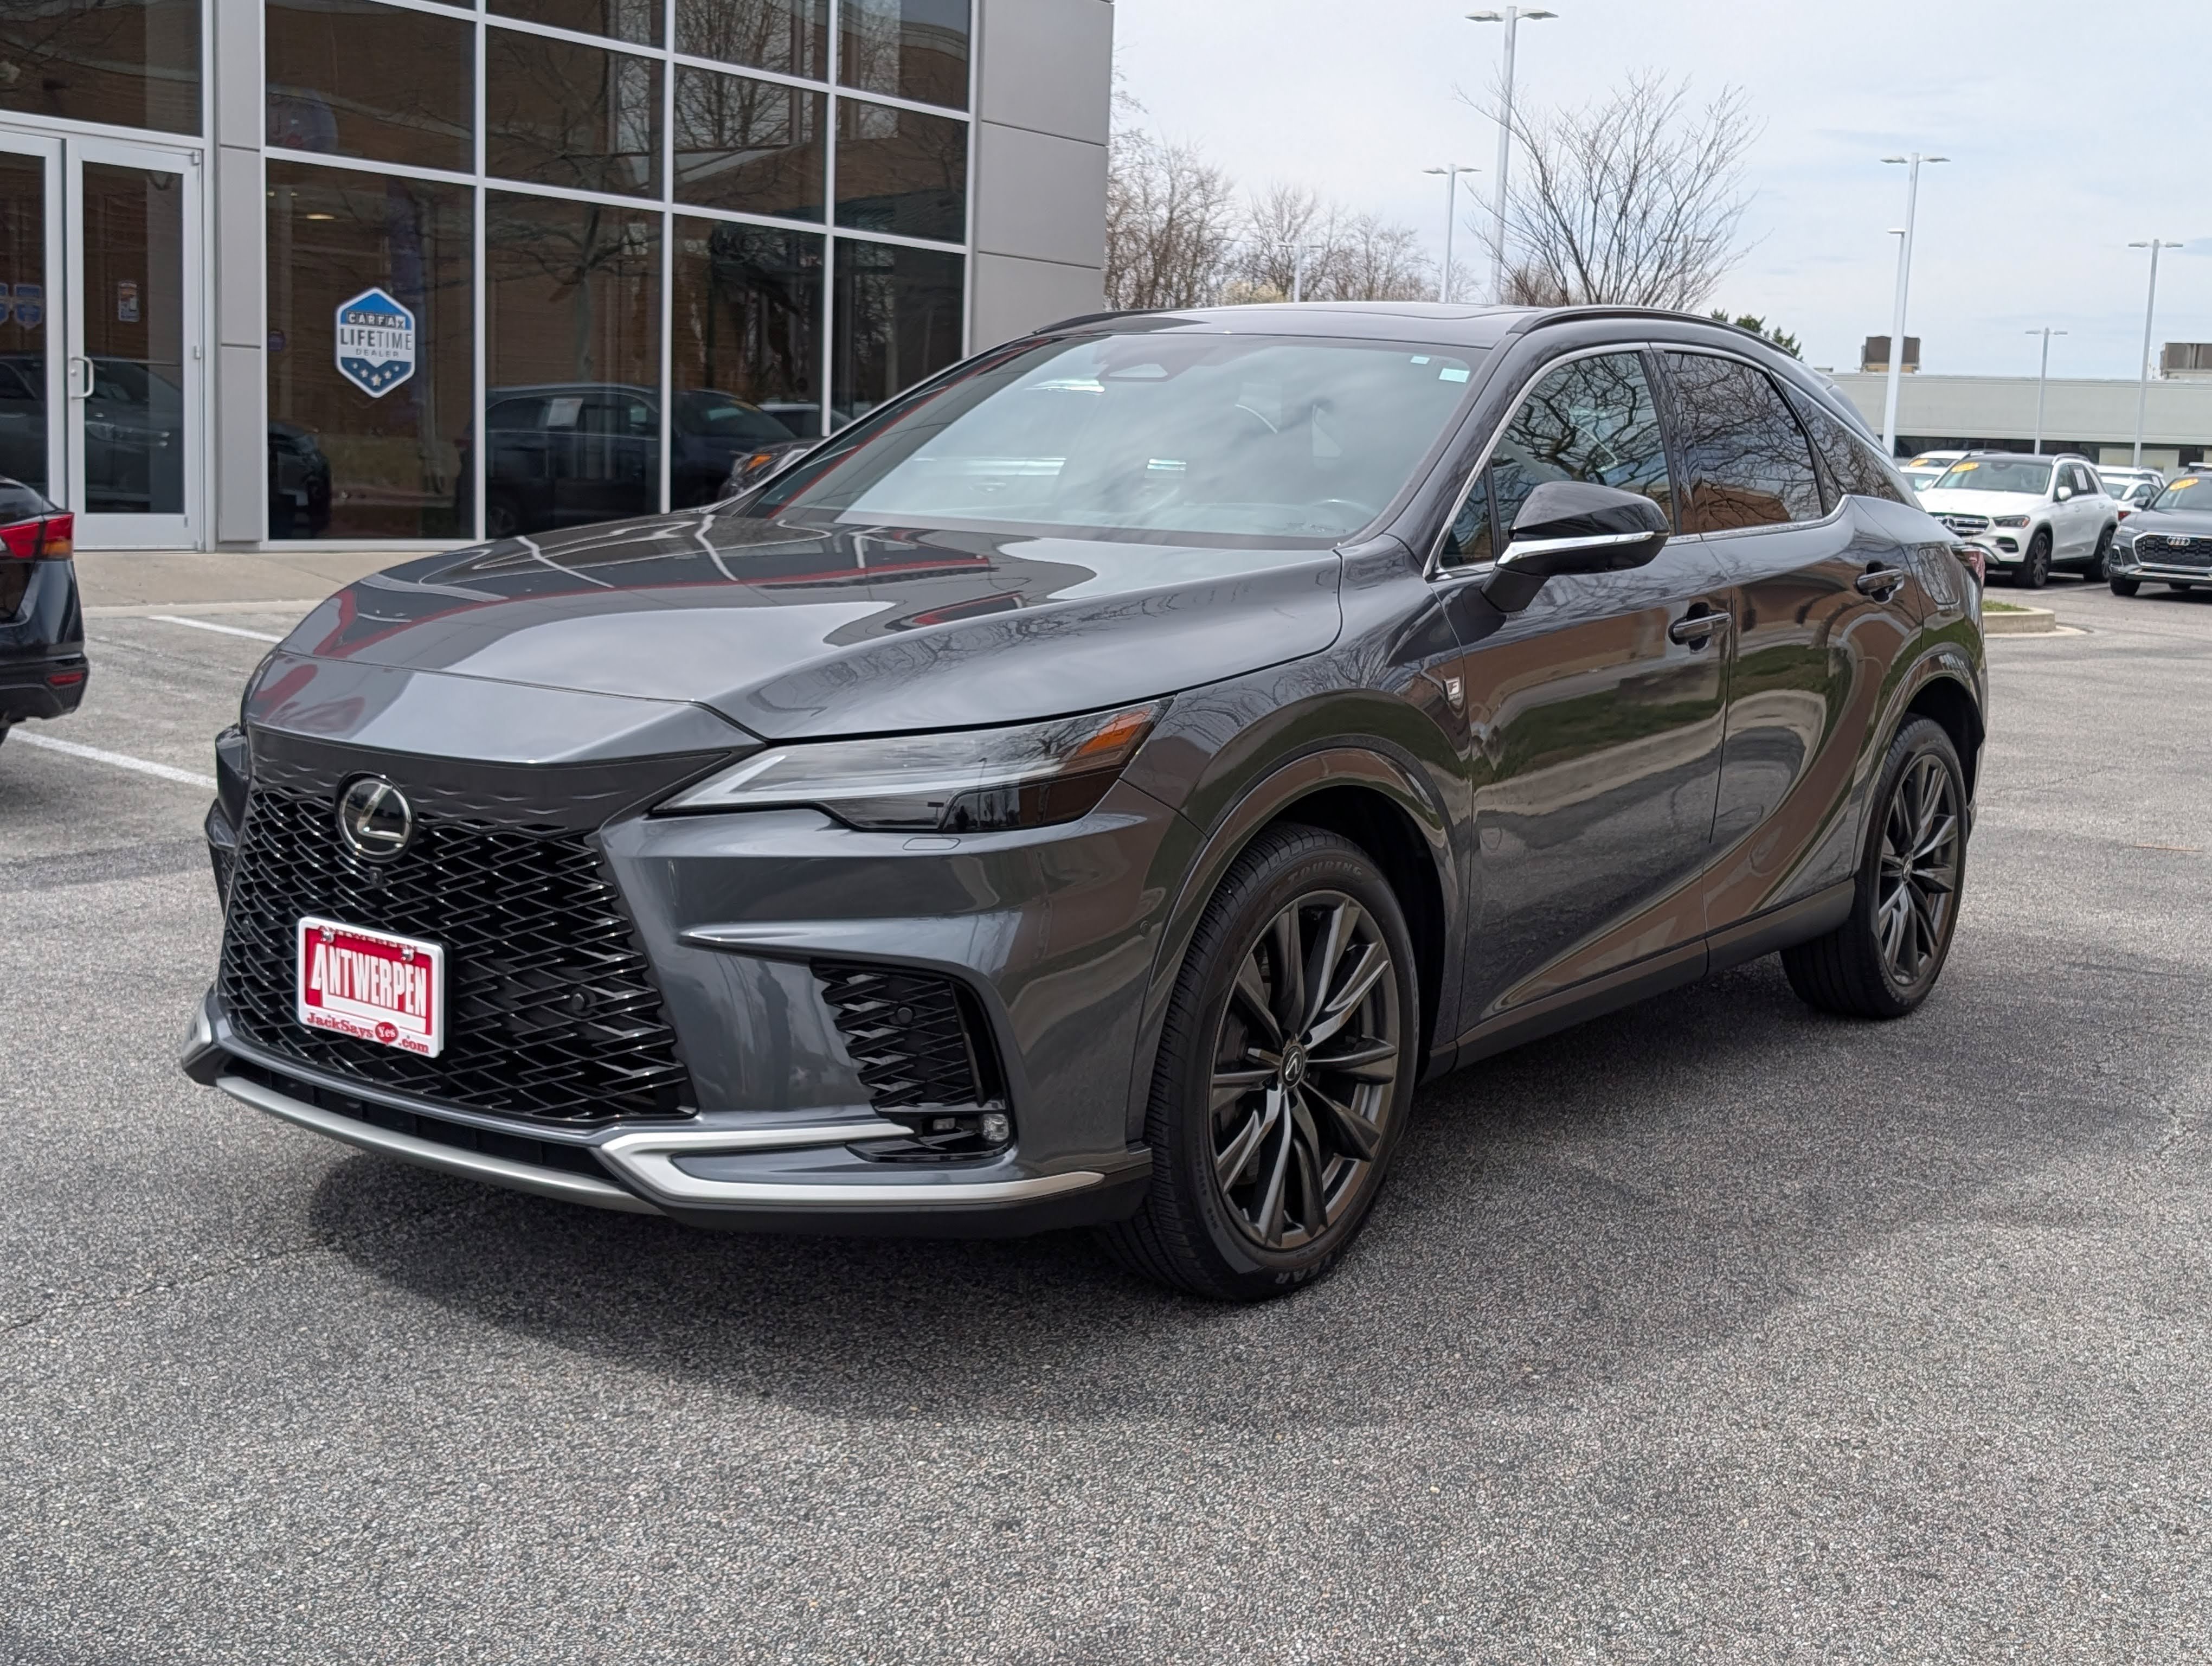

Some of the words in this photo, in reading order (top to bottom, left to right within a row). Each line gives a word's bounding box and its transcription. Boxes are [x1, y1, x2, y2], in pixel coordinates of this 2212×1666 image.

[348, 312, 406, 329] CARFAX
[340, 329, 412, 350] LIFETIME
[356, 349, 399, 357] DEALER
[1288, 861, 1362, 883] TOURING
[310, 943, 427, 1017] ANTWERPEN
[378, 1026, 396, 1039] Yes
